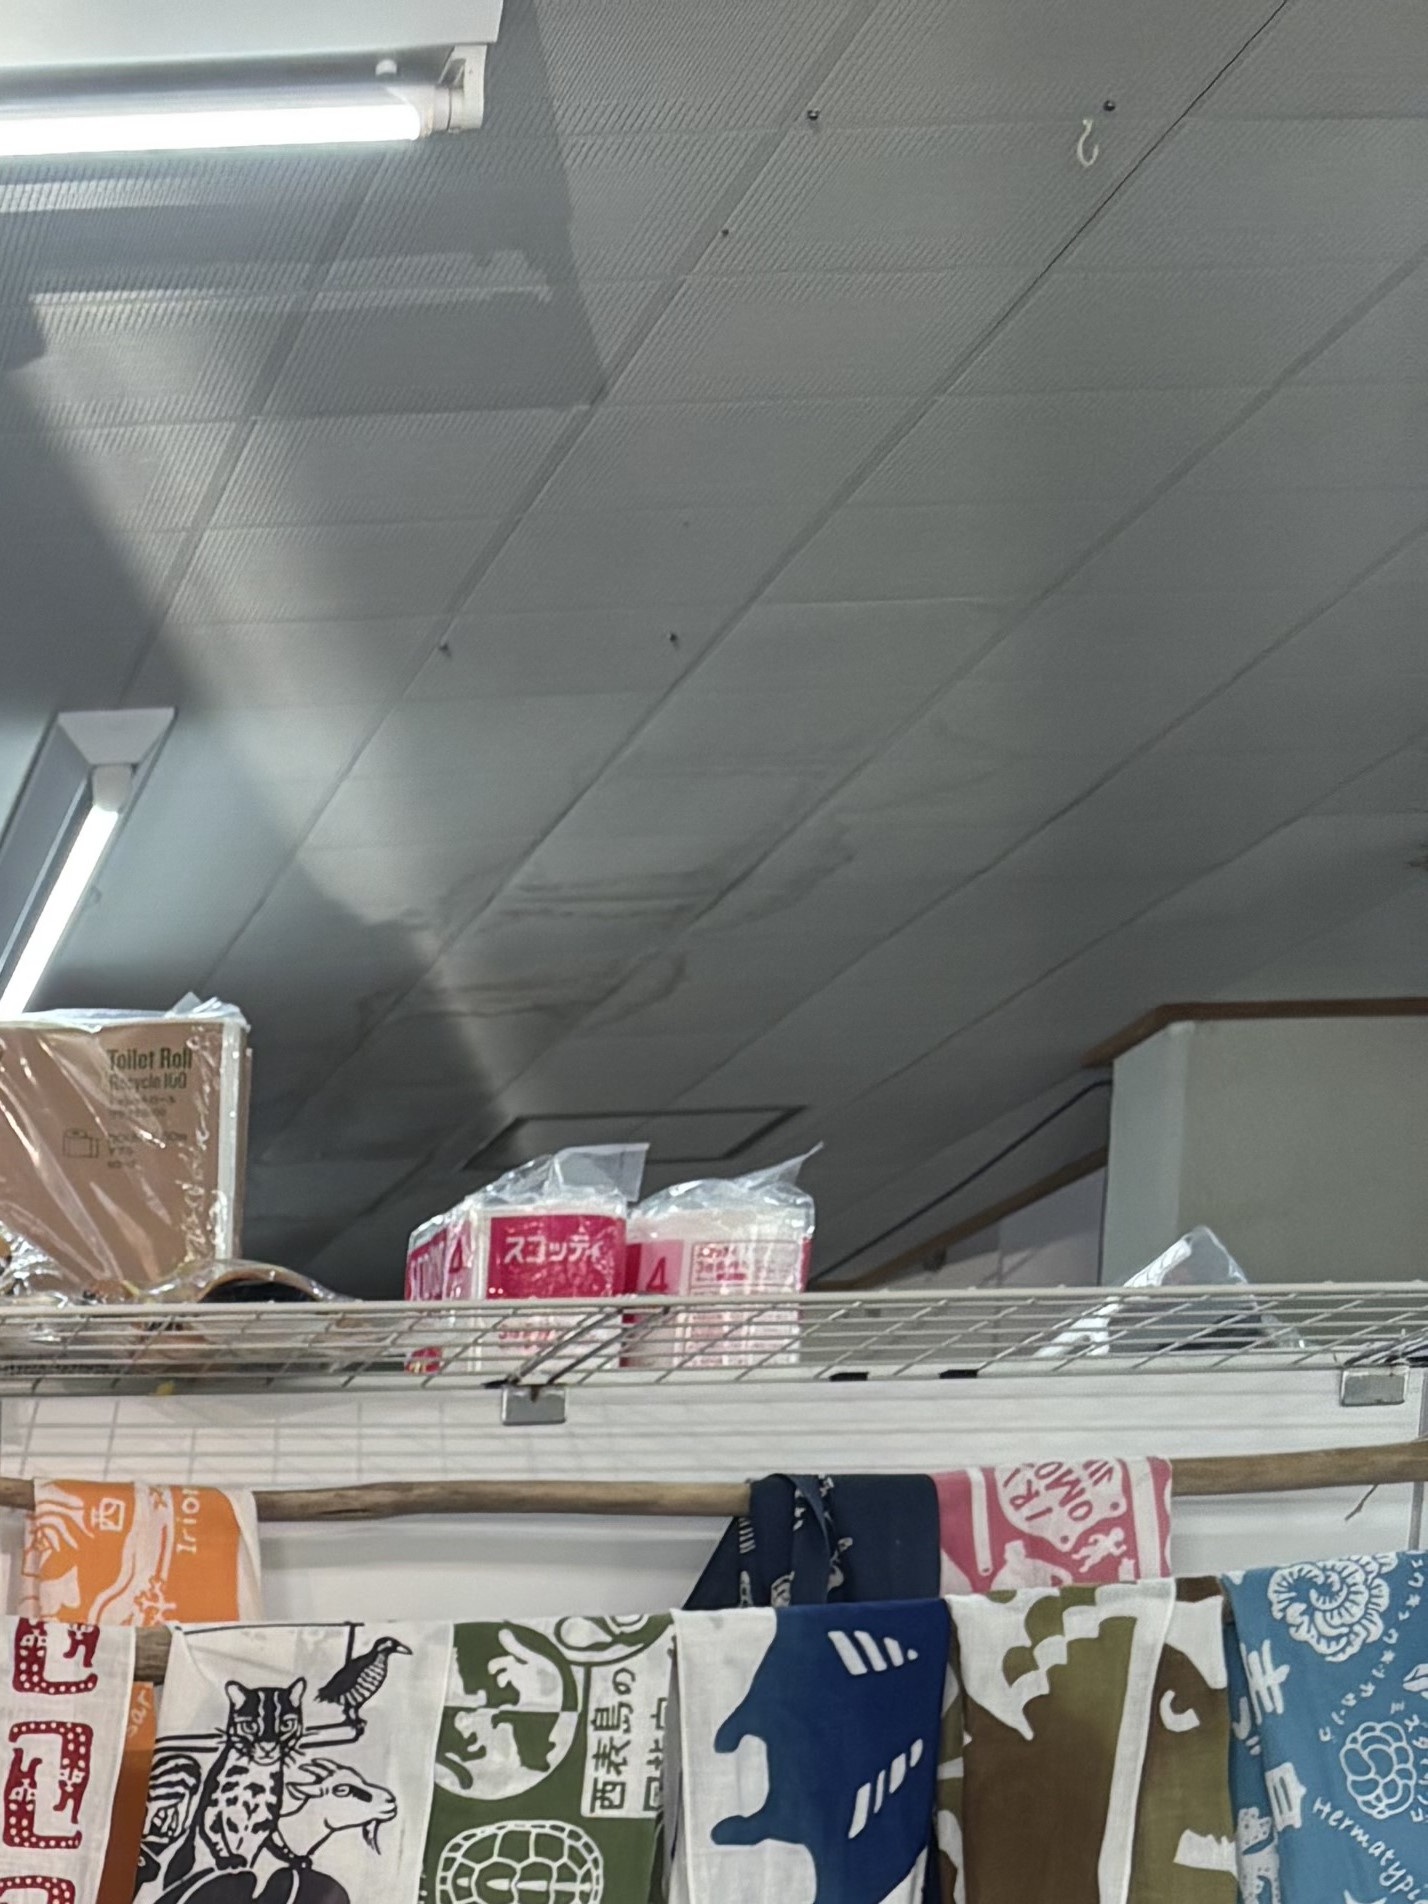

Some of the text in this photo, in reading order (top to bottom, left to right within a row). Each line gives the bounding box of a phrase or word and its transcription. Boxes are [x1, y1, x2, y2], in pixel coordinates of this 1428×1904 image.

[110, 1048, 193, 1070] Toilet Roll
[503, 1235, 604, 1265] スコッティ
[647, 1257, 670, 1292] 4
[590, 1666, 635, 1812] 西表島の
